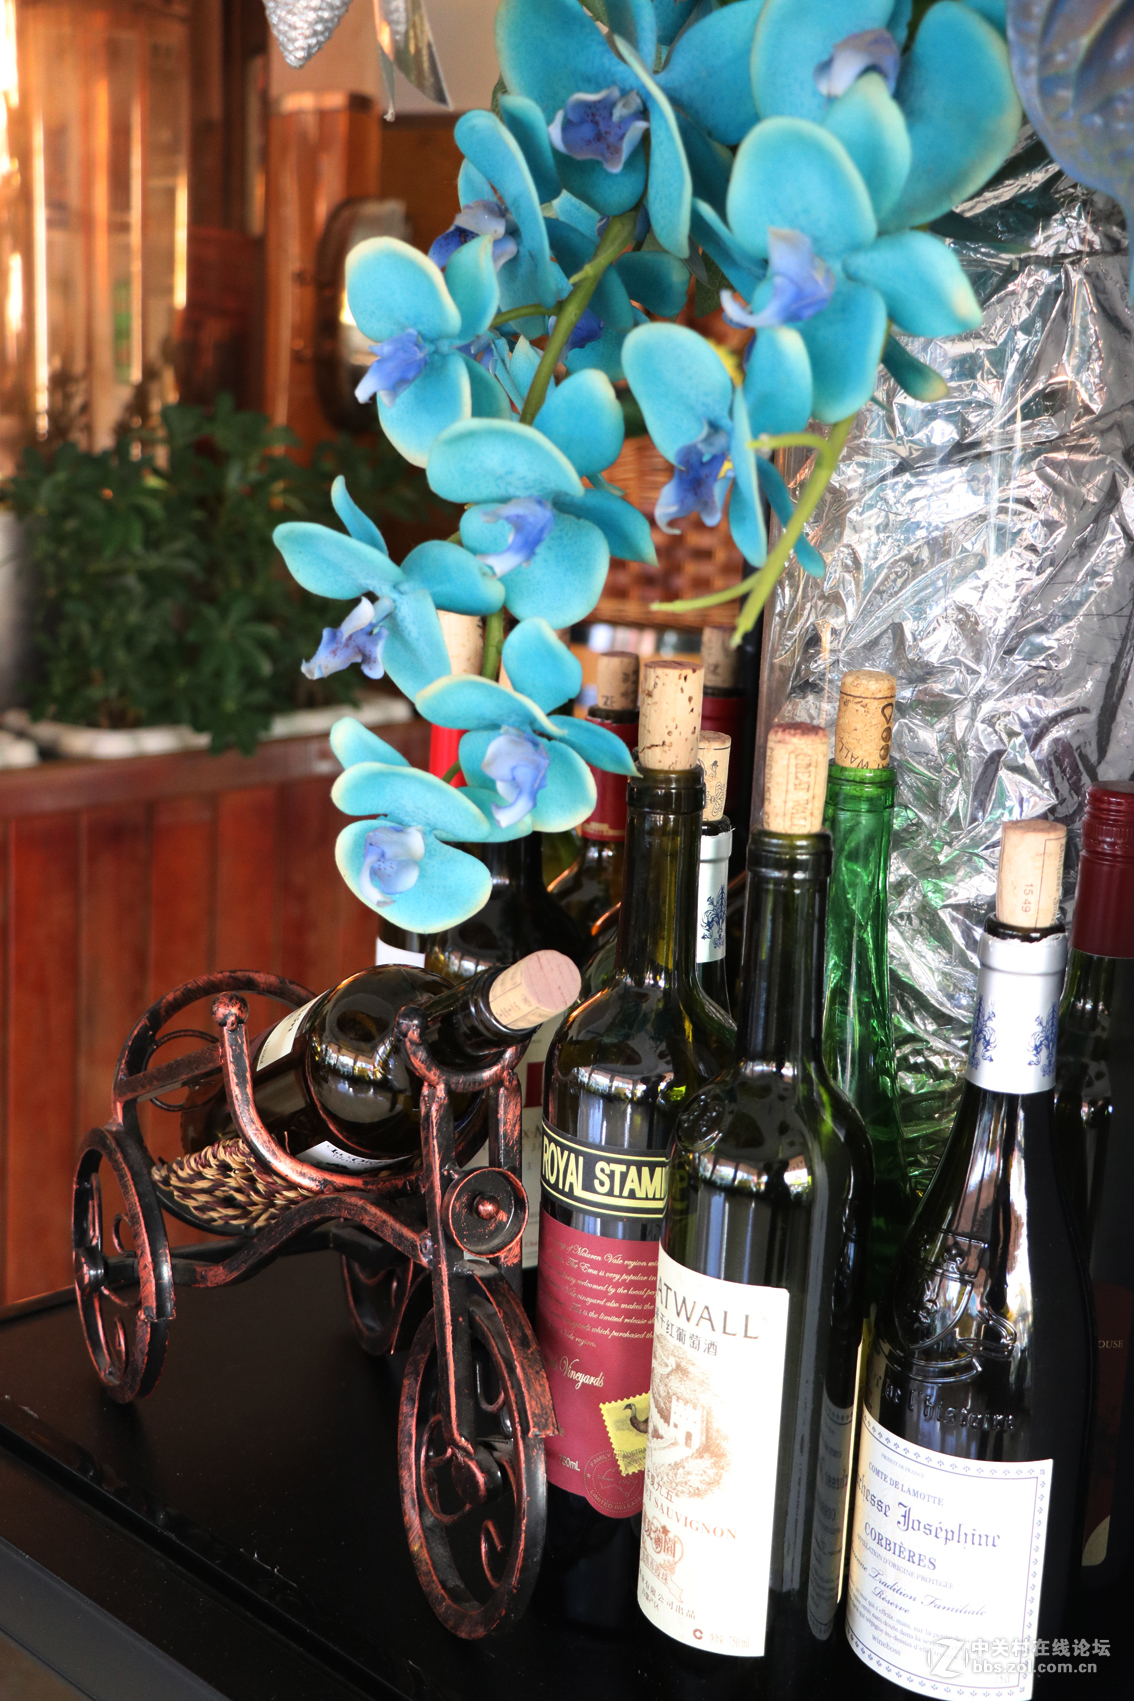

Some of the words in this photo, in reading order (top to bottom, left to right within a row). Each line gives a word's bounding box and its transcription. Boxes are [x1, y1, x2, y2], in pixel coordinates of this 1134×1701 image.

[542, 1135, 584, 1196] ROYAL
[594, 1161, 668, 1199] STAM
[559, 1355, 605, 1391] Vineyards
[868, 1461, 888, 1484] COMTE
[889, 1477, 900, 1490] DE
[900, 1483, 944, 1507] LAMOTTE
[653, 1496, 738, 1541] SAUVIGNON
[896, 1501, 1001, 1550] Joséphine
[864, 1521, 937, 1571] CORBIÈRES
[868, 1566, 918, 1602] Tradition
[920, 1593, 987, 1617] Familiale
[872, 1586, 911, 1614] Réserve
